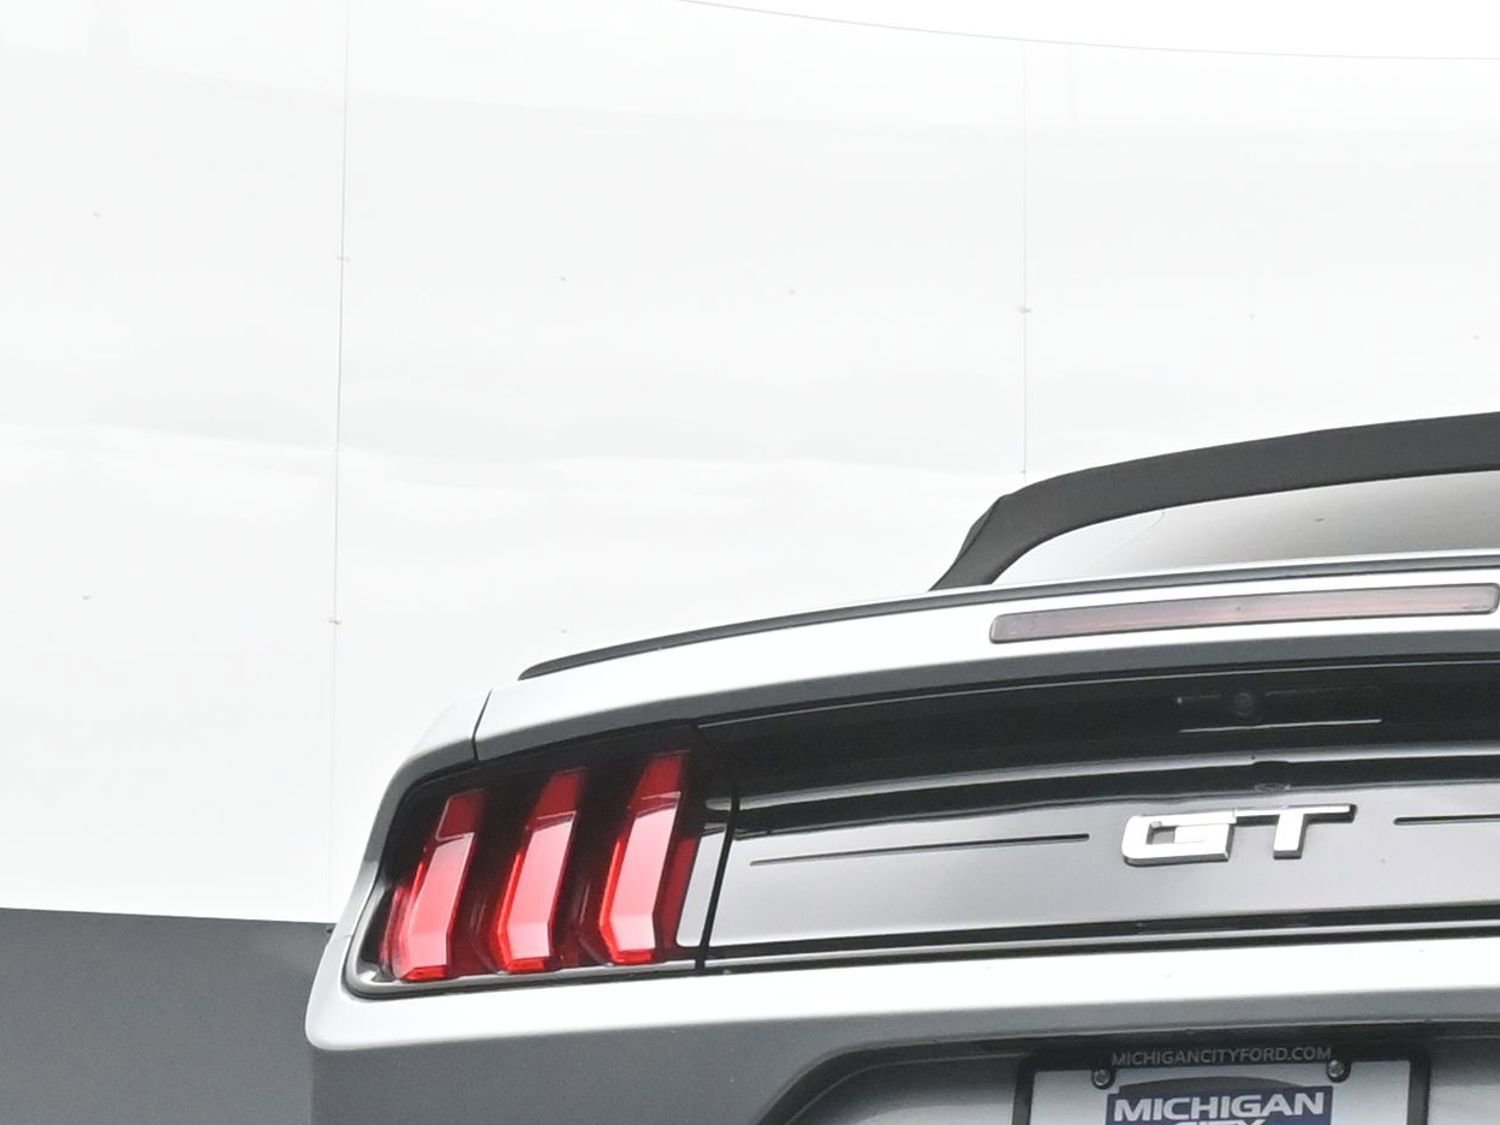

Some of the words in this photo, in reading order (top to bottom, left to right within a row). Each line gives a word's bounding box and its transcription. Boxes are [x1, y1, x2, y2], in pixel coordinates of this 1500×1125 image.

[1122, 803, 1357, 867] GT
[1111, 1046, 1332, 1067] MICHIGANCITYFORD.COM
[1113, 1092, 1325, 1121] MICHIGAN
